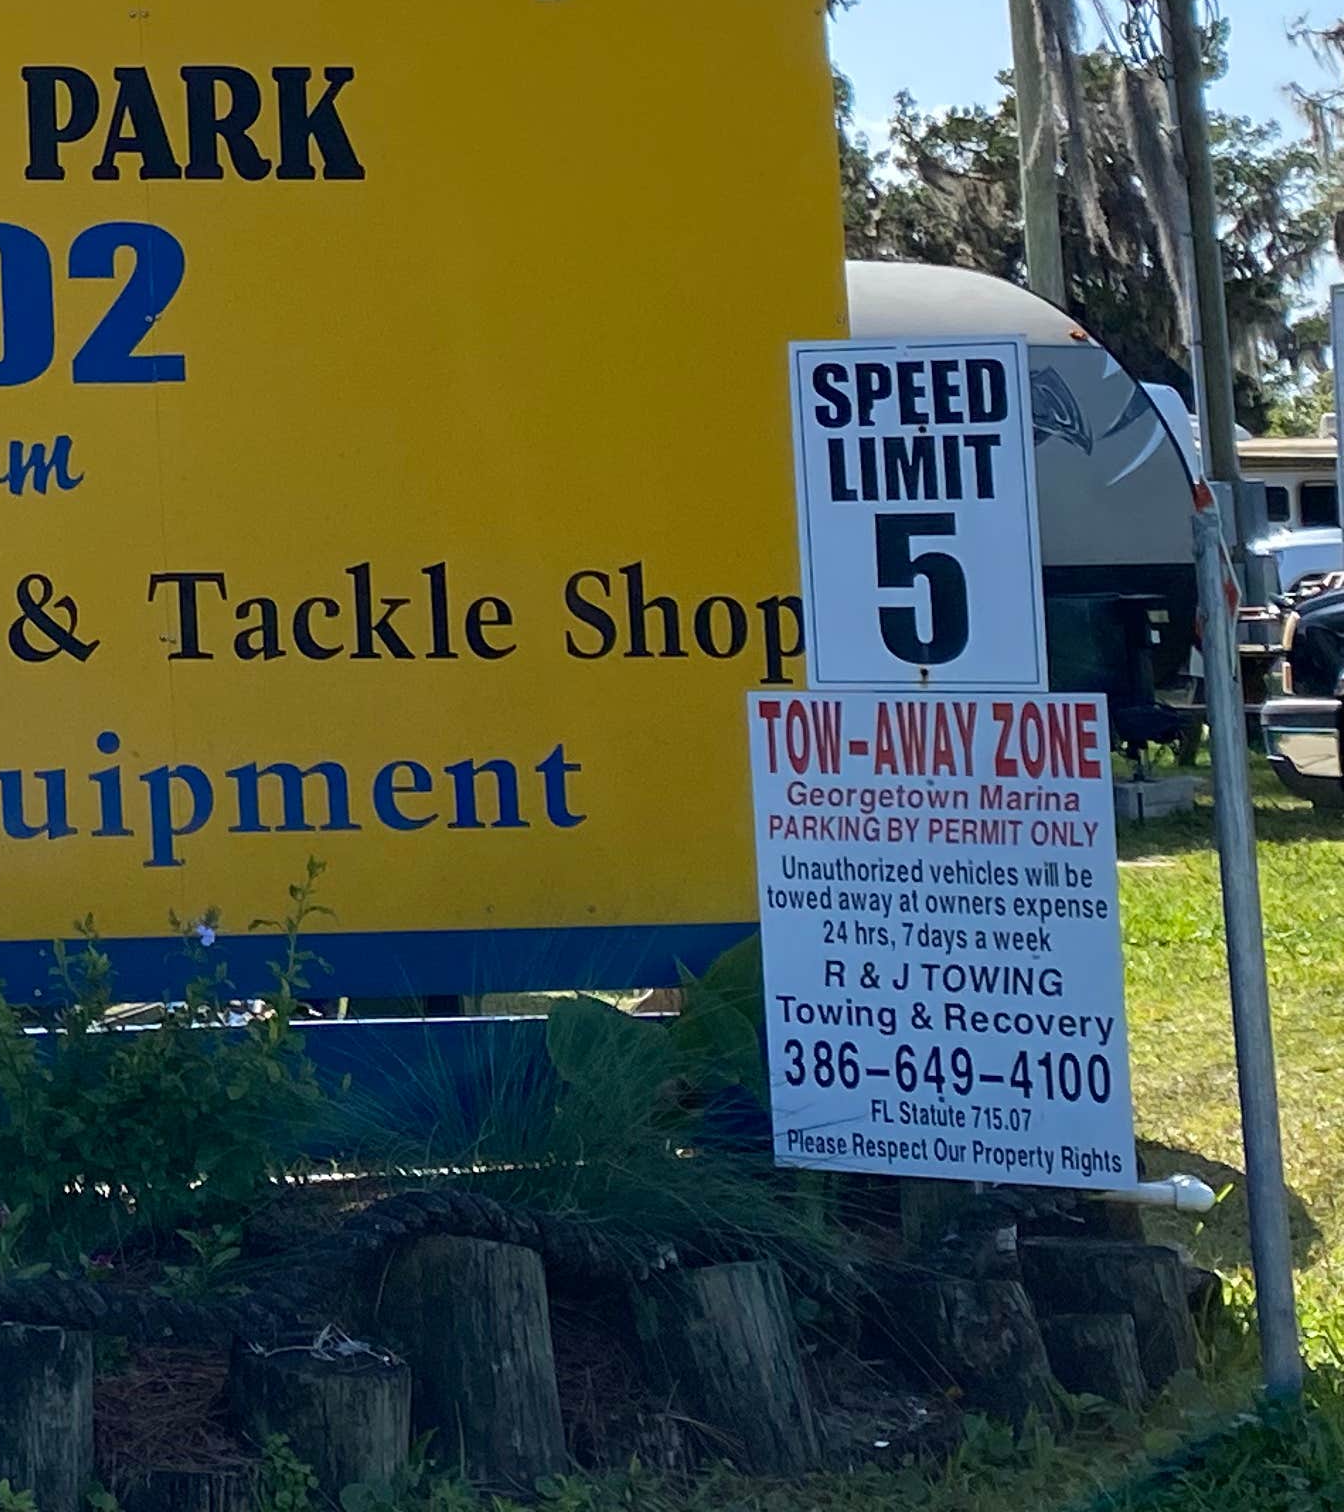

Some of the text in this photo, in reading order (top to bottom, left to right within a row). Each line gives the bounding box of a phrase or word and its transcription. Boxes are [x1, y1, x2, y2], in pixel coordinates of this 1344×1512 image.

[24, 65, 366, 183] PARK
[812, 359, 1007, 428] SPEED
[828, 434, 1000, 501] LIMIT
[875, 512, 969, 665] 5
[7, 572, 101, 664] &
[147, 561, 518, 663] Tackle
[563, 561, 806, 684] Shop
[759, 700, 1102, 779] TOW-AWAY ZONE
[787, 781, 1080, 813] Georgetown Marina
[769, 815, 1098, 847] PARKING BY PERMIT ONLY
[782, 855, 1092, 888] Unauthorized vehicles will be
[767, 886, 1108, 923] towed away at owners expense
[823, 920, 1052, 954] 24 hrs, 7 days a week
[825, 960, 1063, 996] R & J TOWING
[776, 996, 1113, 1045] Towing & Recovery
[784, 1039, 1110, 1103] 386-649-4100
[872, 1100, 1031, 1131] FL Statute 715.07
[787, 1129, 1122, 1177] Please Respect Our Property Rights
